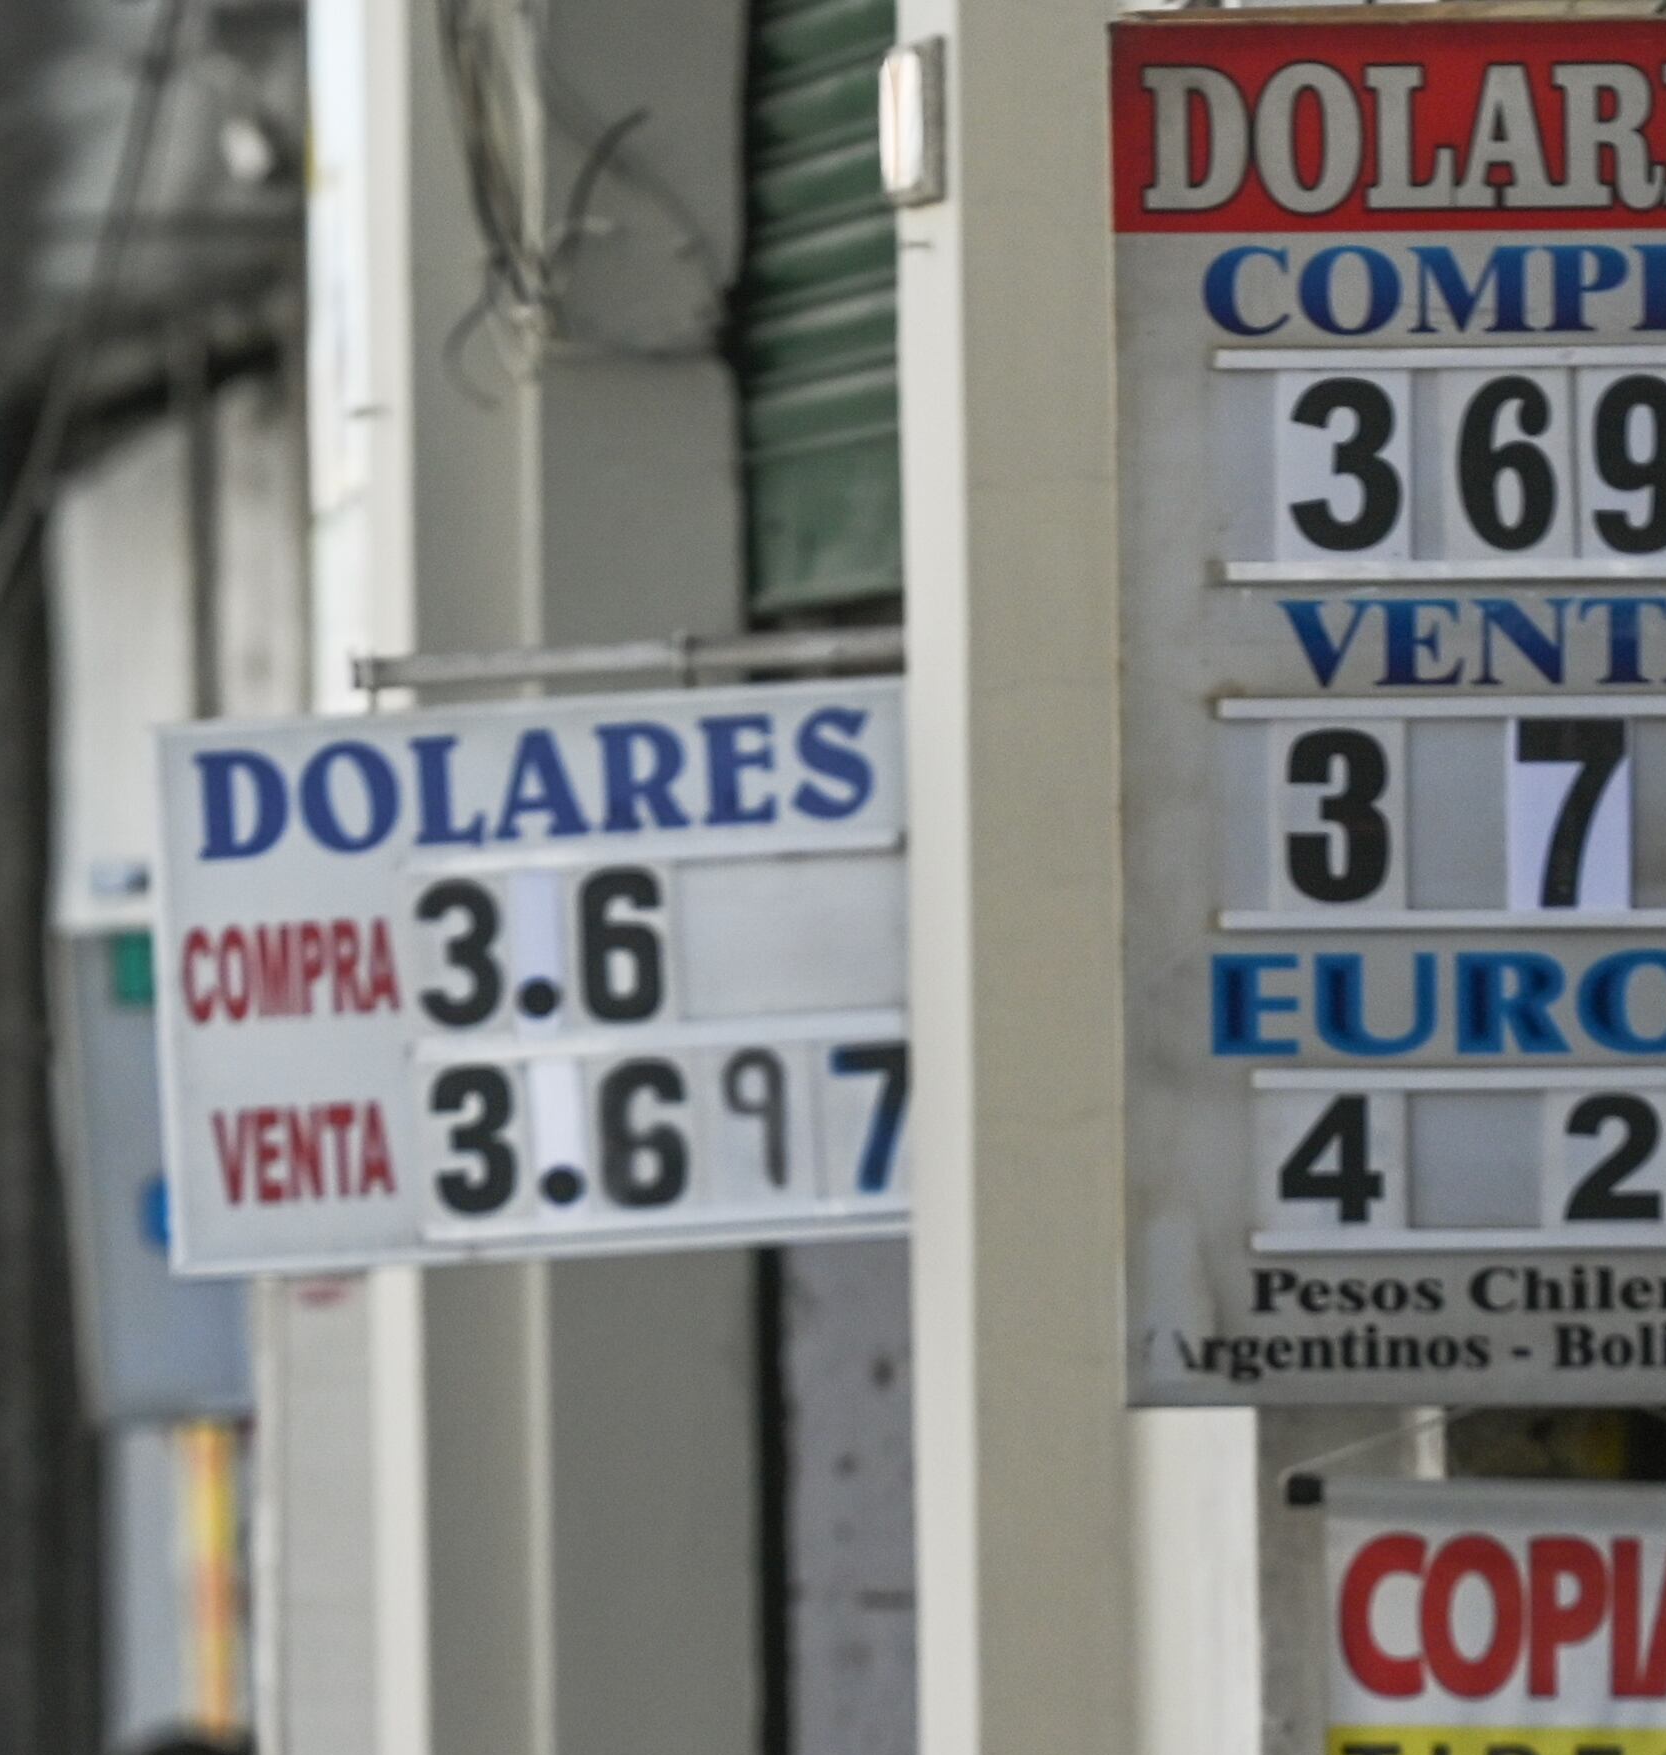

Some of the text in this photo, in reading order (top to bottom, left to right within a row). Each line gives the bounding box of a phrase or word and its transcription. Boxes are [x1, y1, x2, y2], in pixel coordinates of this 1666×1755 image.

[192, 706, 875, 861] DOLARES
[181, 865, 665, 1029] COMPRA 3.6
[211, 1102, 397, 1206] VENTA
[1251, 1266, 1445, 1314] Pesos
